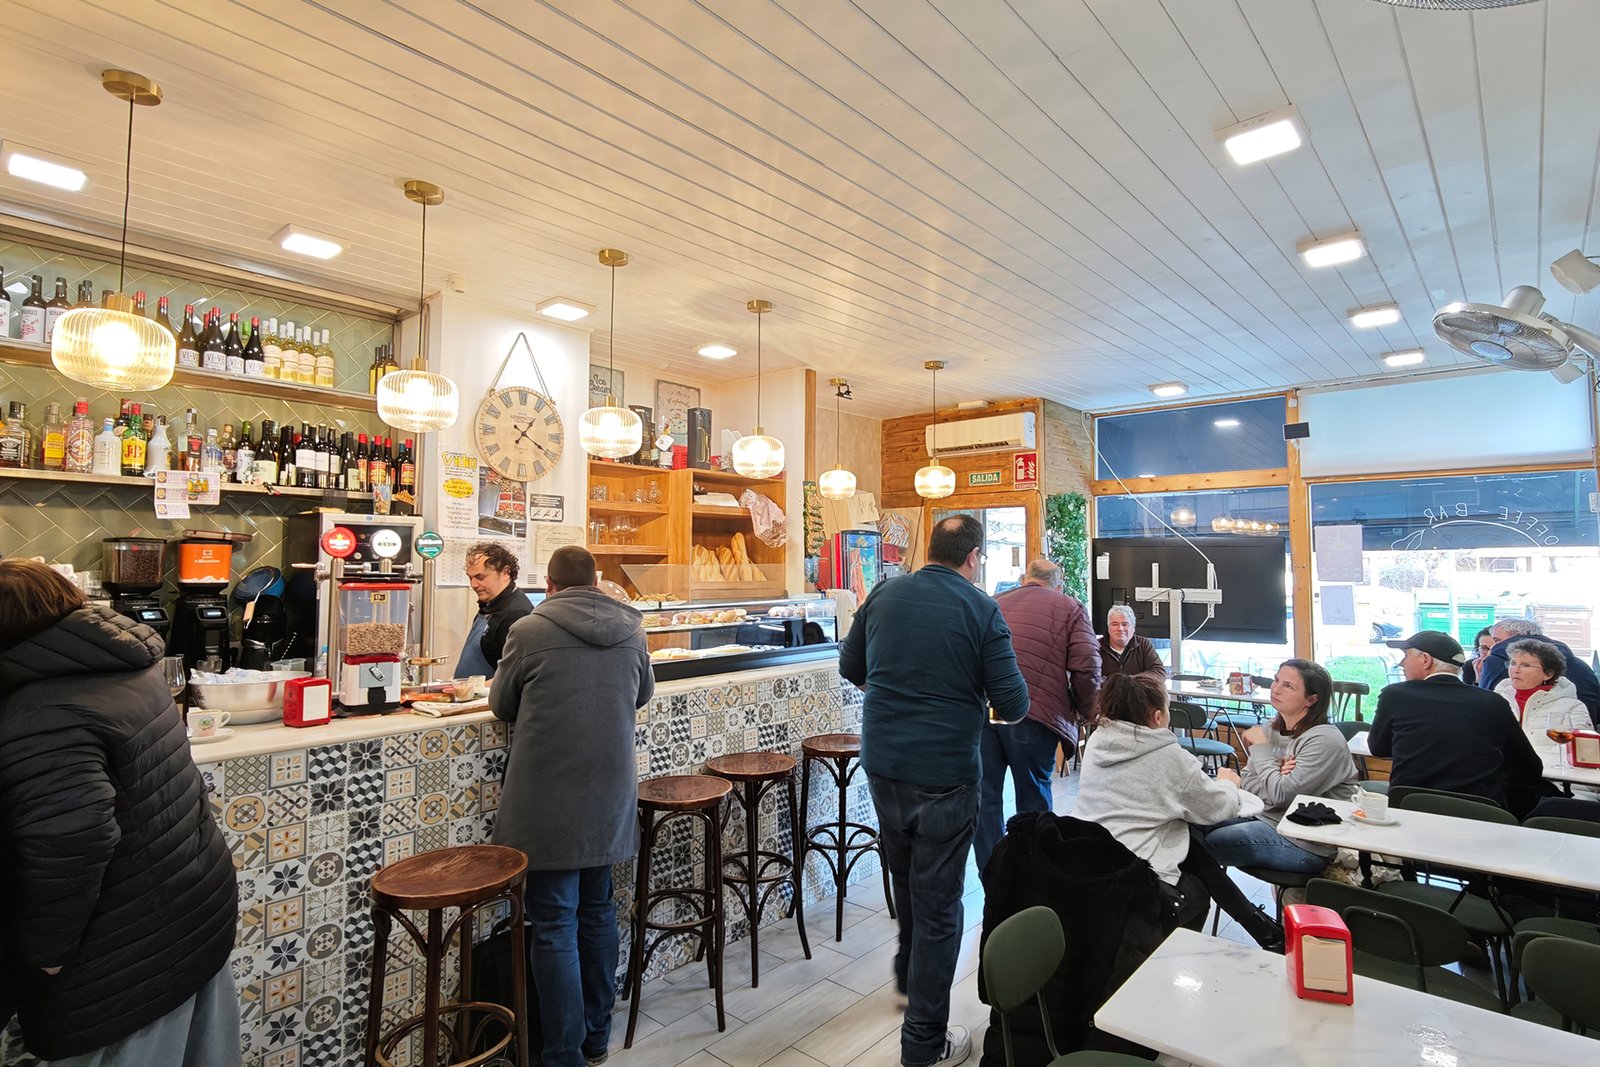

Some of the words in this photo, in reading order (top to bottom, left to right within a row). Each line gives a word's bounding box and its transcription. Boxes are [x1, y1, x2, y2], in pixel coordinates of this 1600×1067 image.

[206, 352, 225, 364] VI-VE
[593, 374, 608, 386] Ice
[124, 445, 143, 459] J&B
[972, 473, 998, 483] SALIDA
